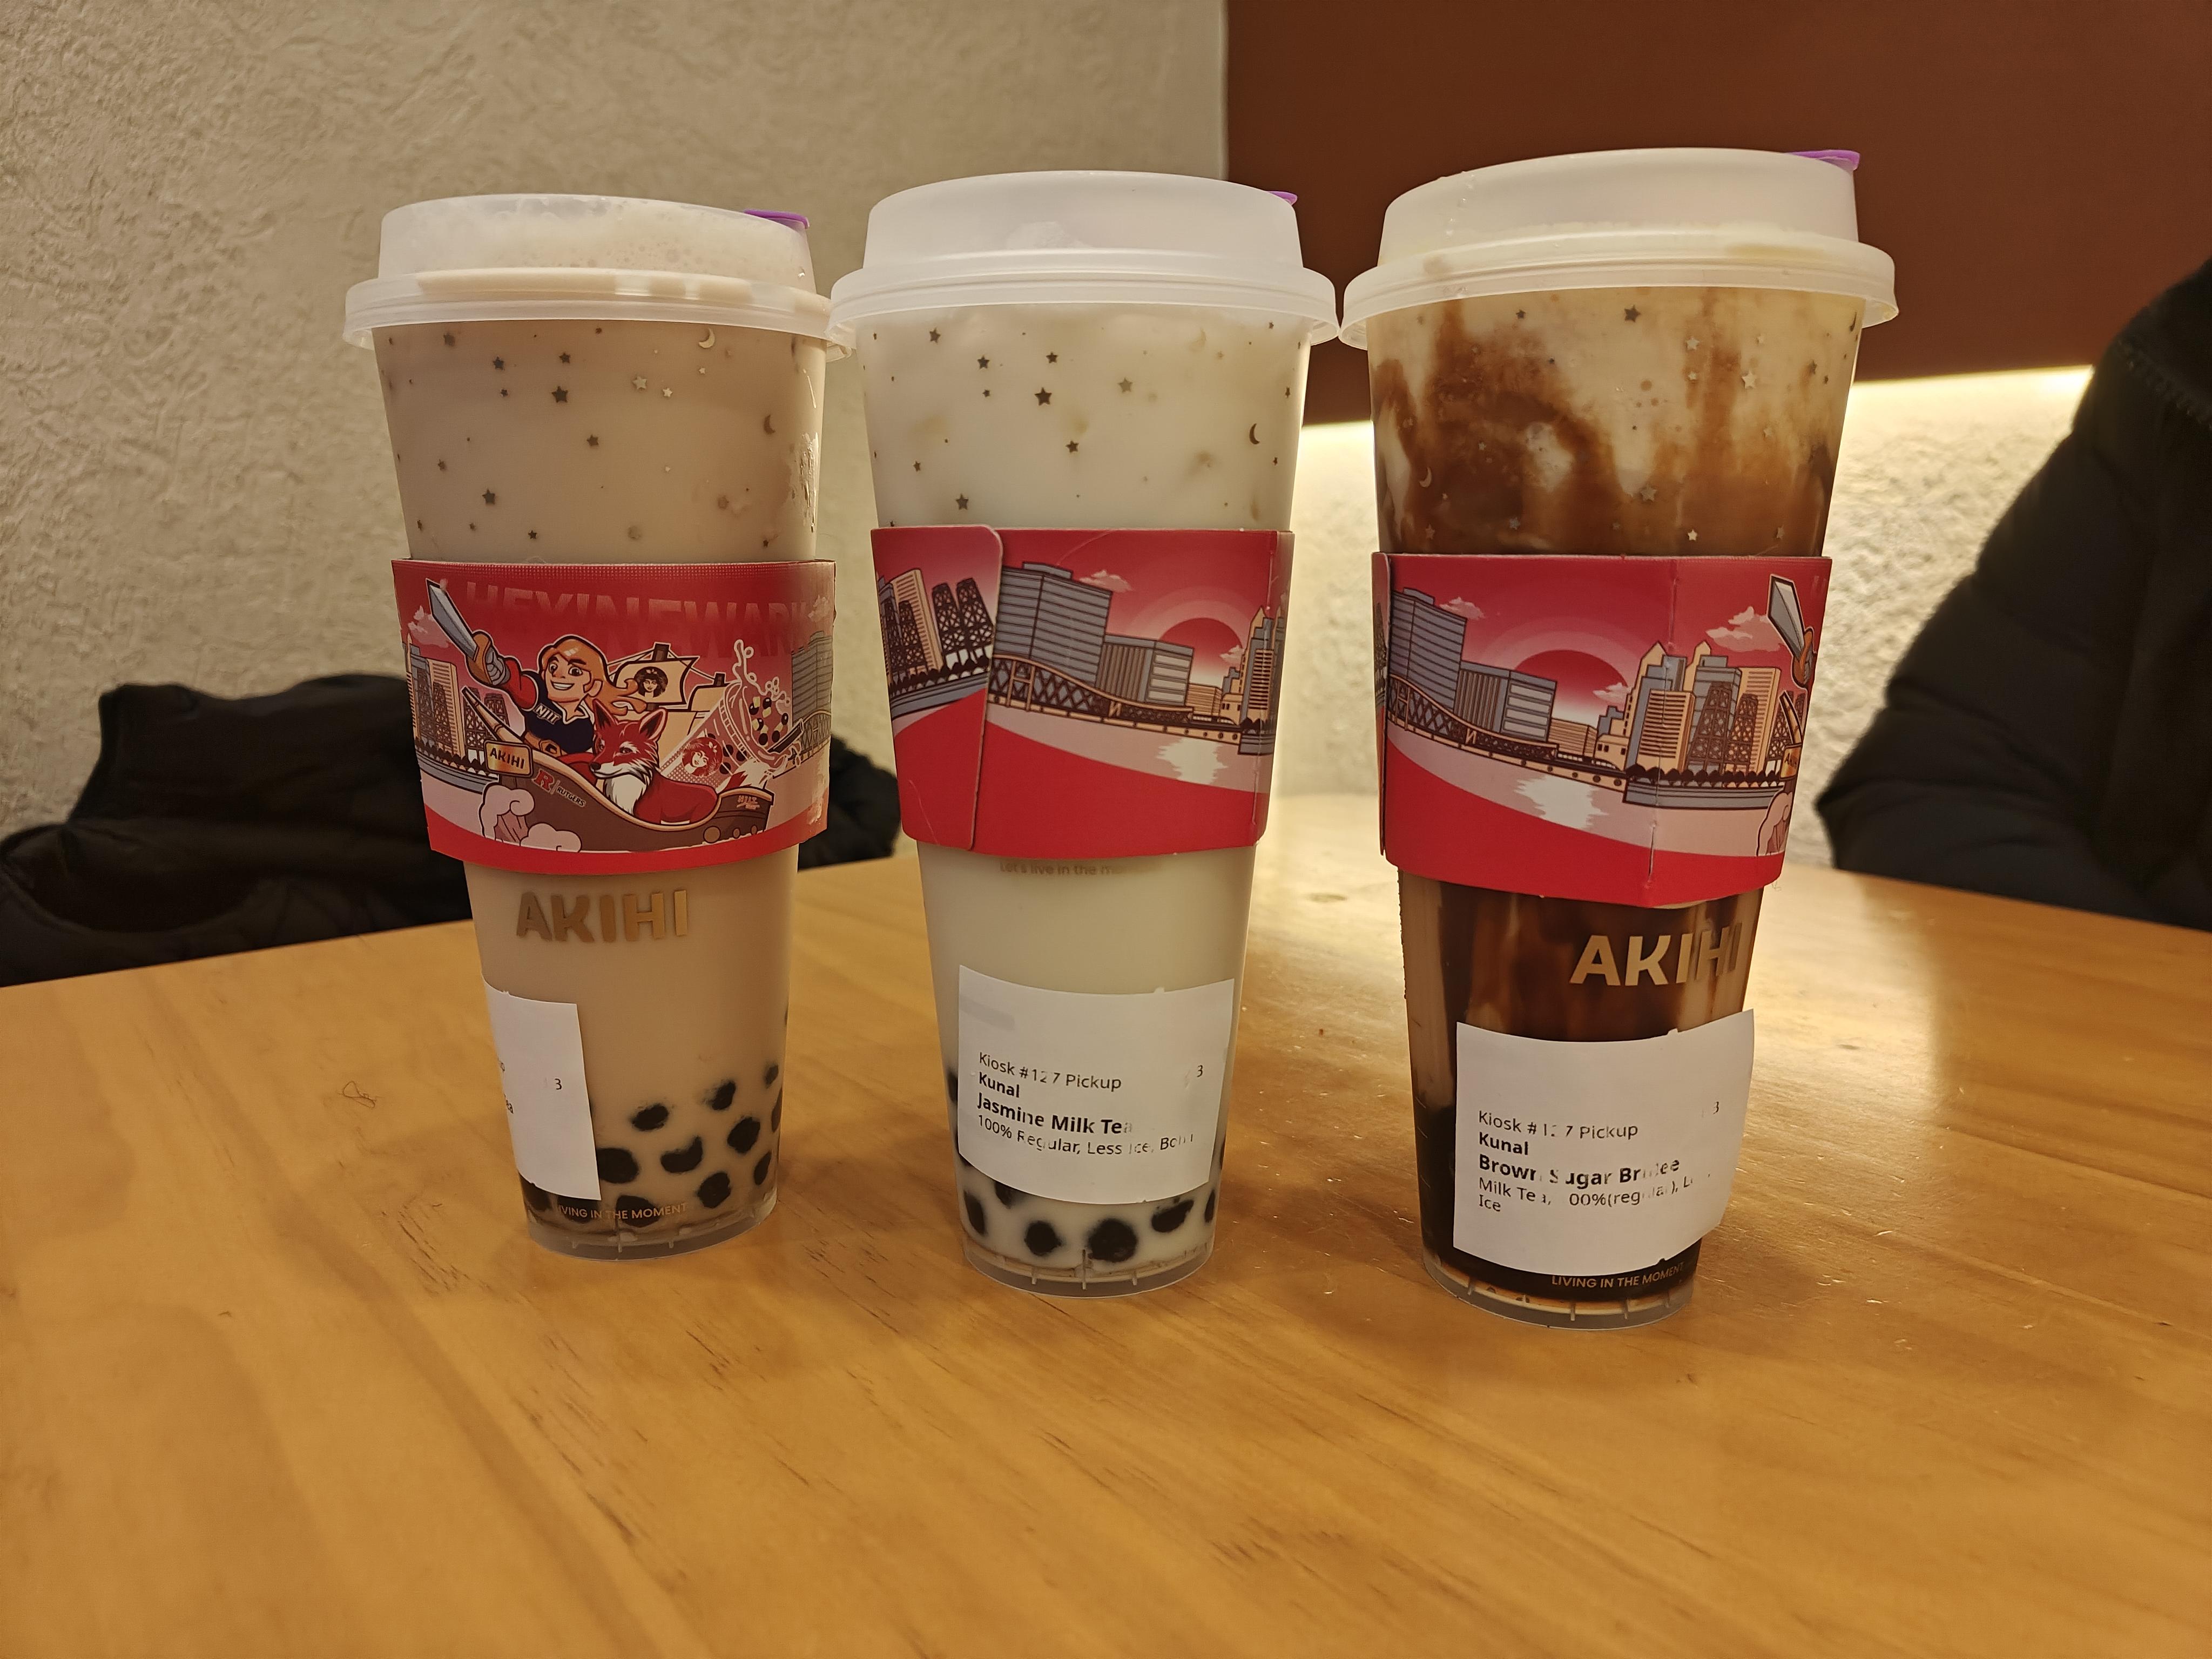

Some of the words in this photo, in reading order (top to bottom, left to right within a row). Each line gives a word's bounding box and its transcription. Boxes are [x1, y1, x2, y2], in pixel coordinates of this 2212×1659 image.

[535, 704, 561, 723] NJIT
[490, 747, 525, 769] AKIHI
[556, 786, 585, 806] RUTGERS
[516, 889, 688, 943] AKIHI
[1568, 922, 1742, 986] AKIHI
[554, 1078, 562, 1090] 3
[979, 1052, 1015, 1075] Kiosk
[1065, 1074, 1122, 1092] Pickup
[979, 1072, 1020, 1098] Kunal
[977, 1092, 1044, 1127] Jasmine
[1051, 1115, 1095, 1134] Milk
[1101, 1119, 1132, 1134] Tea
[1479, 1110, 1521, 1132] Kiosk
[1580, 1125, 1638, 1140] Pickup
[978, 1115, 1013, 1139] 100%
[1087, 1142, 1123, 1155] Less
[1479, 1132, 1528, 1156] Kunal
[1479, 1177, 1511, 1197] Milk
[591, 1210, 602, 1219] IN
[605, 1210, 628, 1219] THE
[632, 1203, 687, 1219] MOMENT
[1479, 1195, 1501, 1212] Ice
[1552, 1275, 1597, 1288] LIVING
[1600, 1278, 1614, 1288] IN
[1617, 1275, 1640, 1287] THE
[1642, 1262, 1683, 1284] MOMENT
